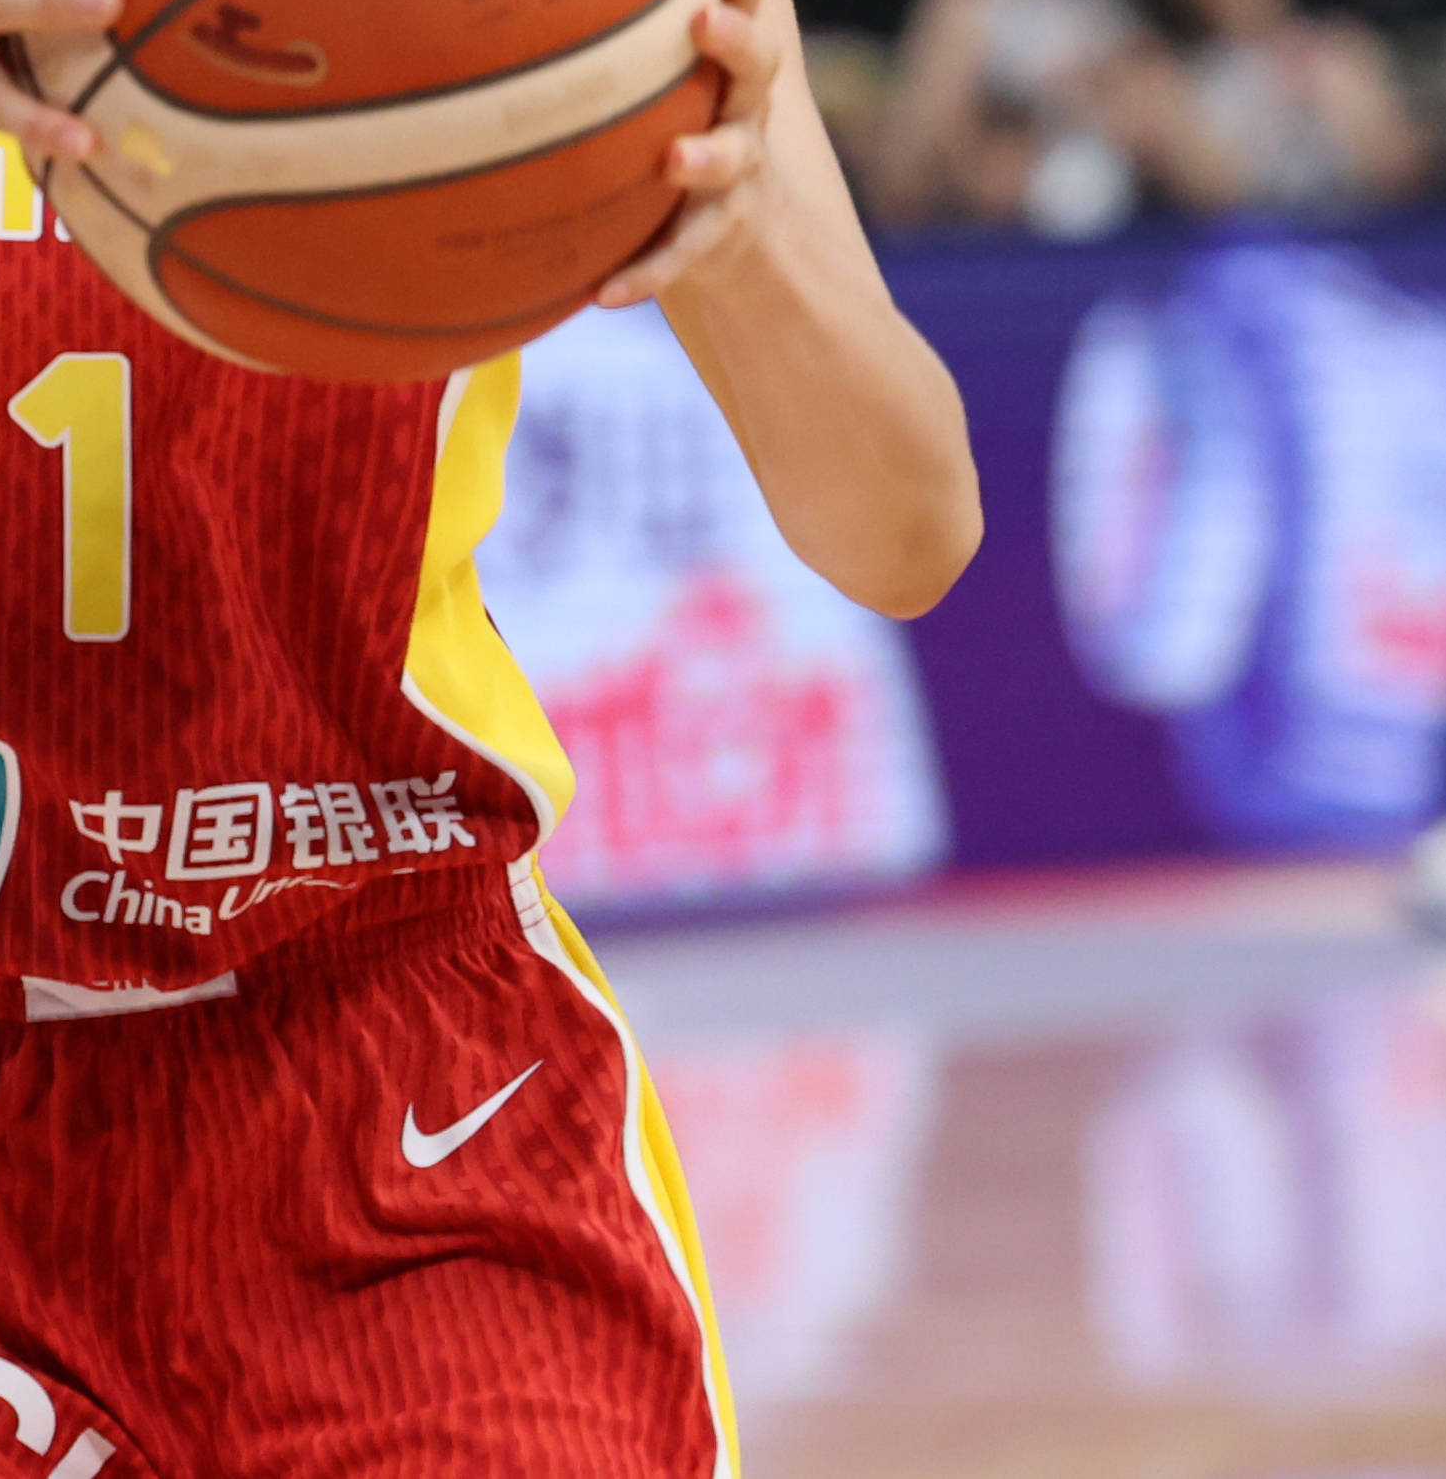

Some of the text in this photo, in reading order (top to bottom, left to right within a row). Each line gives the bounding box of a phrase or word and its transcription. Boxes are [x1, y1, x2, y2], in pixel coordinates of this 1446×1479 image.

[8, 353, 133, 642] 1
[69, 770, 477, 881] 中国银联
[60, 869, 212, 936] China
